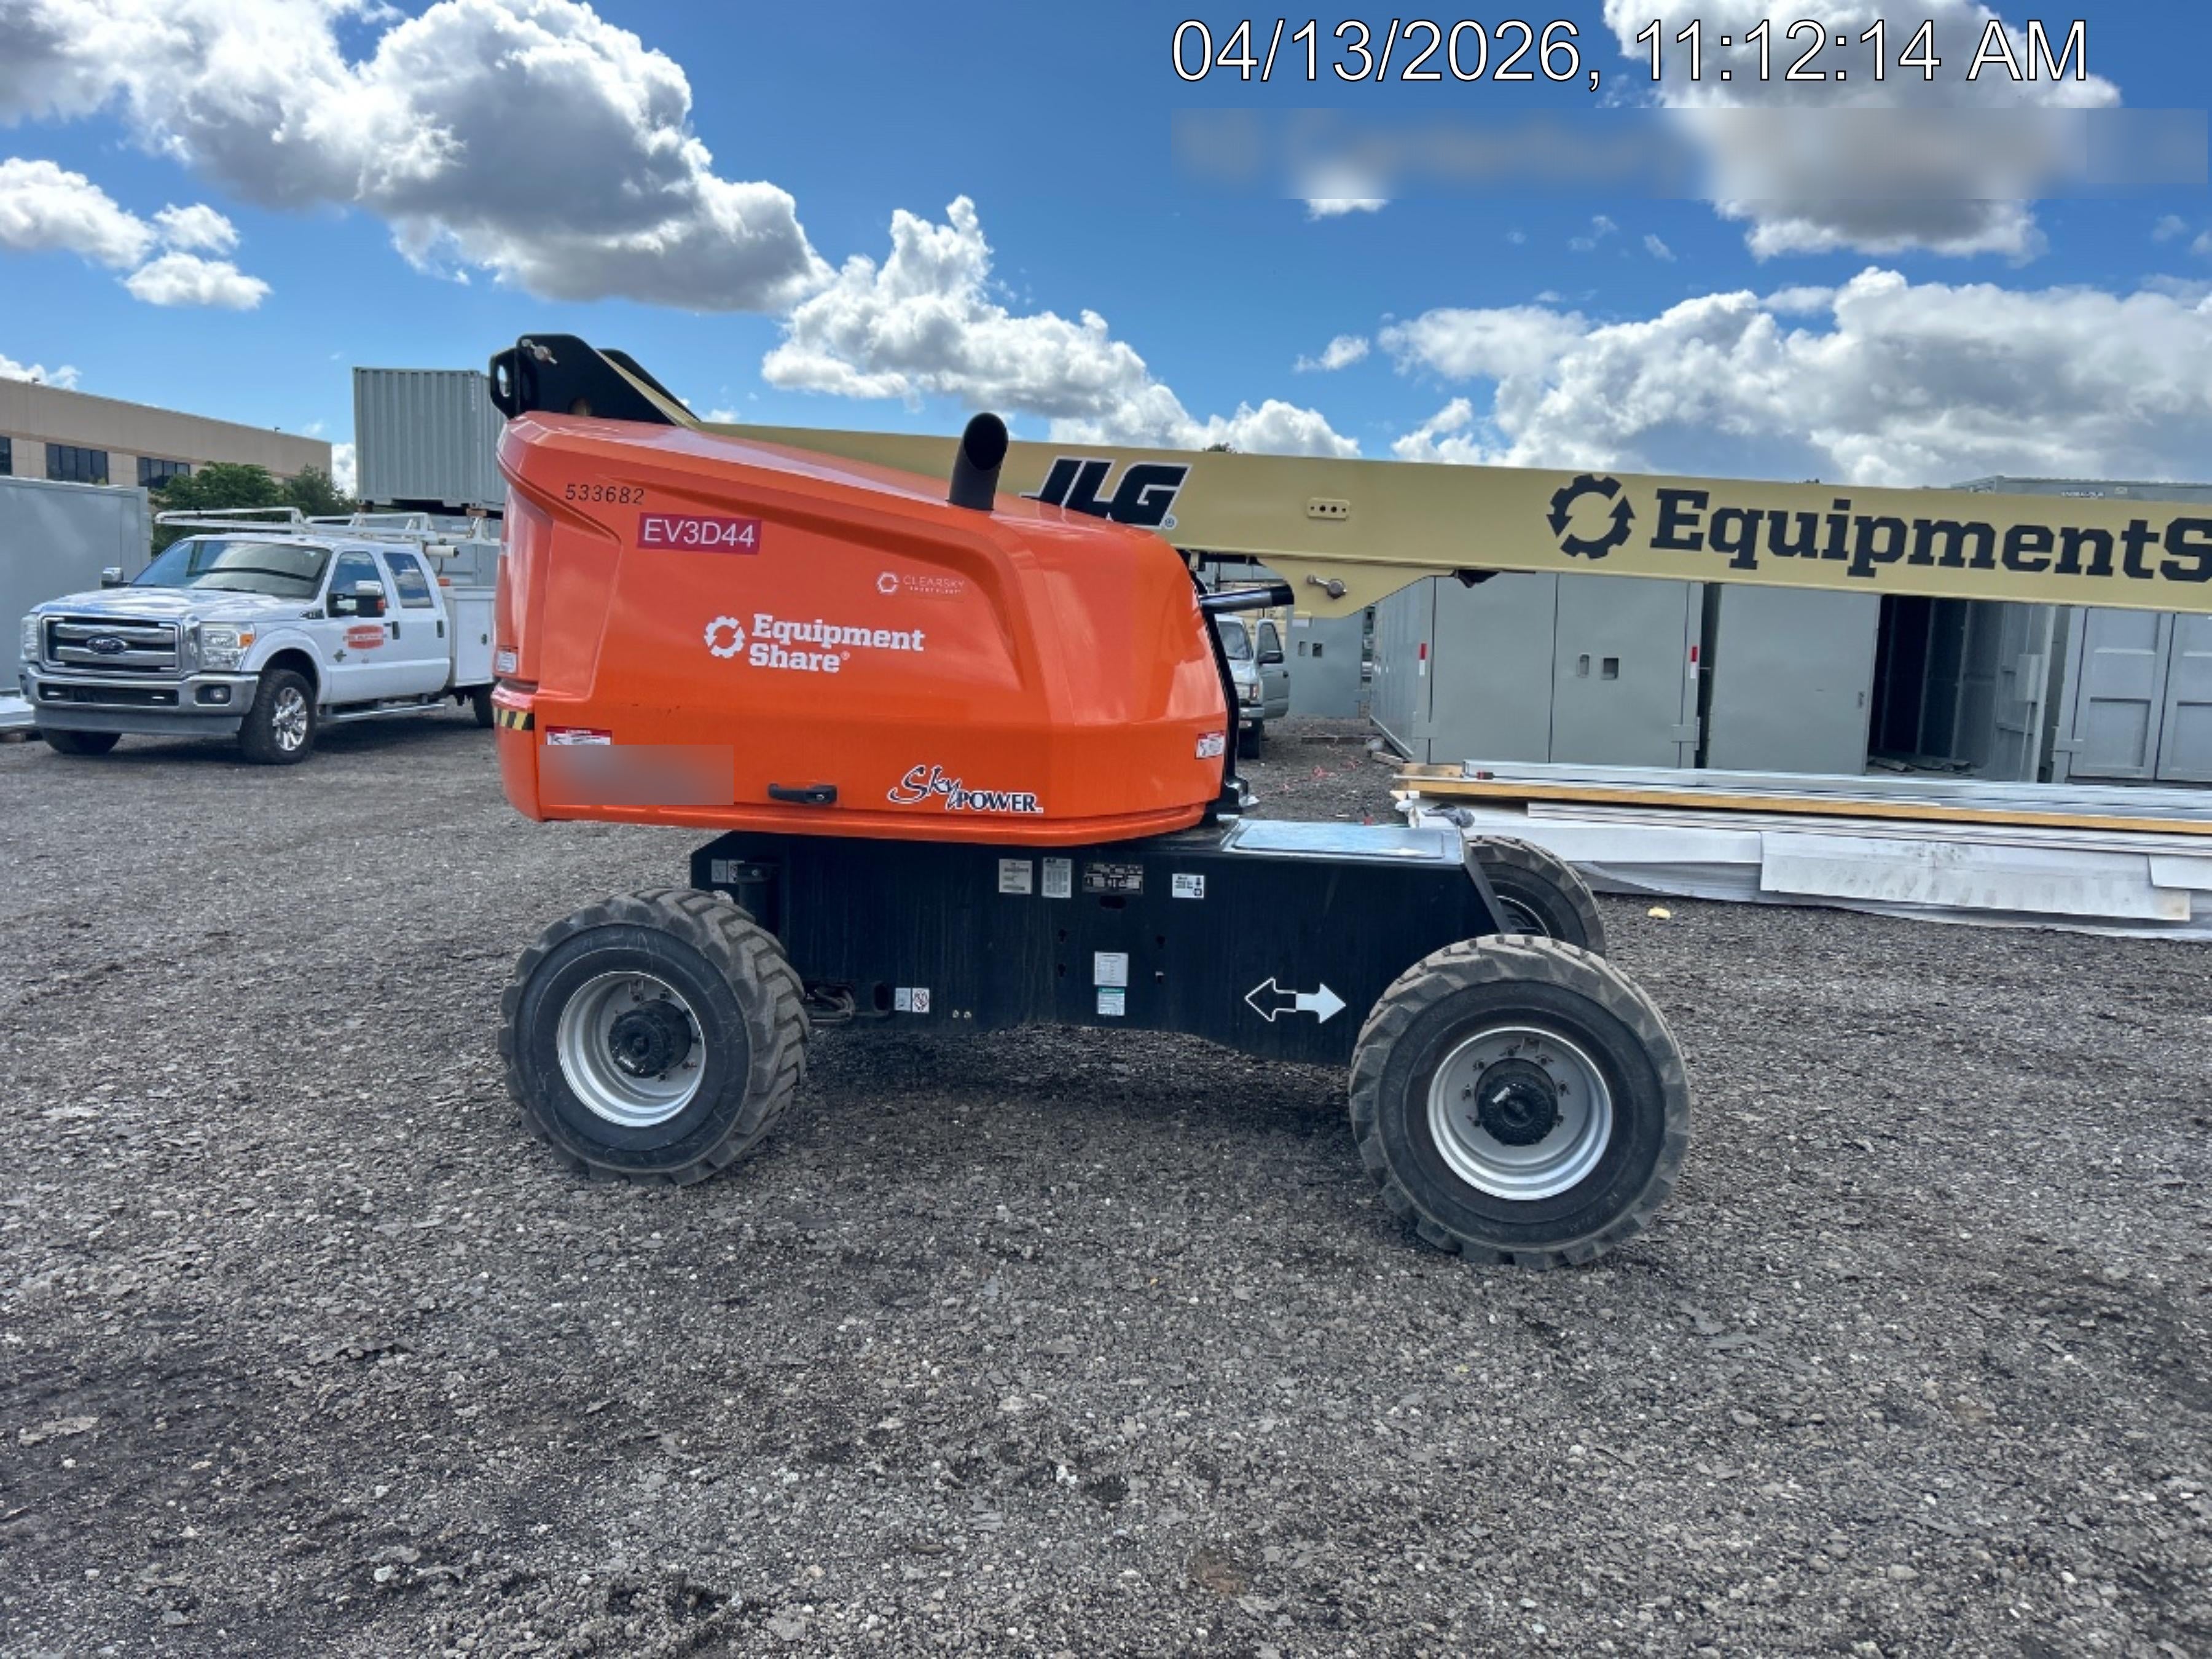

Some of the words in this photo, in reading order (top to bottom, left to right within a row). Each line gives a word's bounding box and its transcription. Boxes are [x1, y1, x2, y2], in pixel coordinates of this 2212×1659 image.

[565, 483, 645, 505] 533682
[643, 518, 755, 547] EV3D44
[1650, 487, 2212, 583] EquipmentS
[903, 575, 965, 589] CLEARSKY
[751, 613, 925, 651] Equipment
